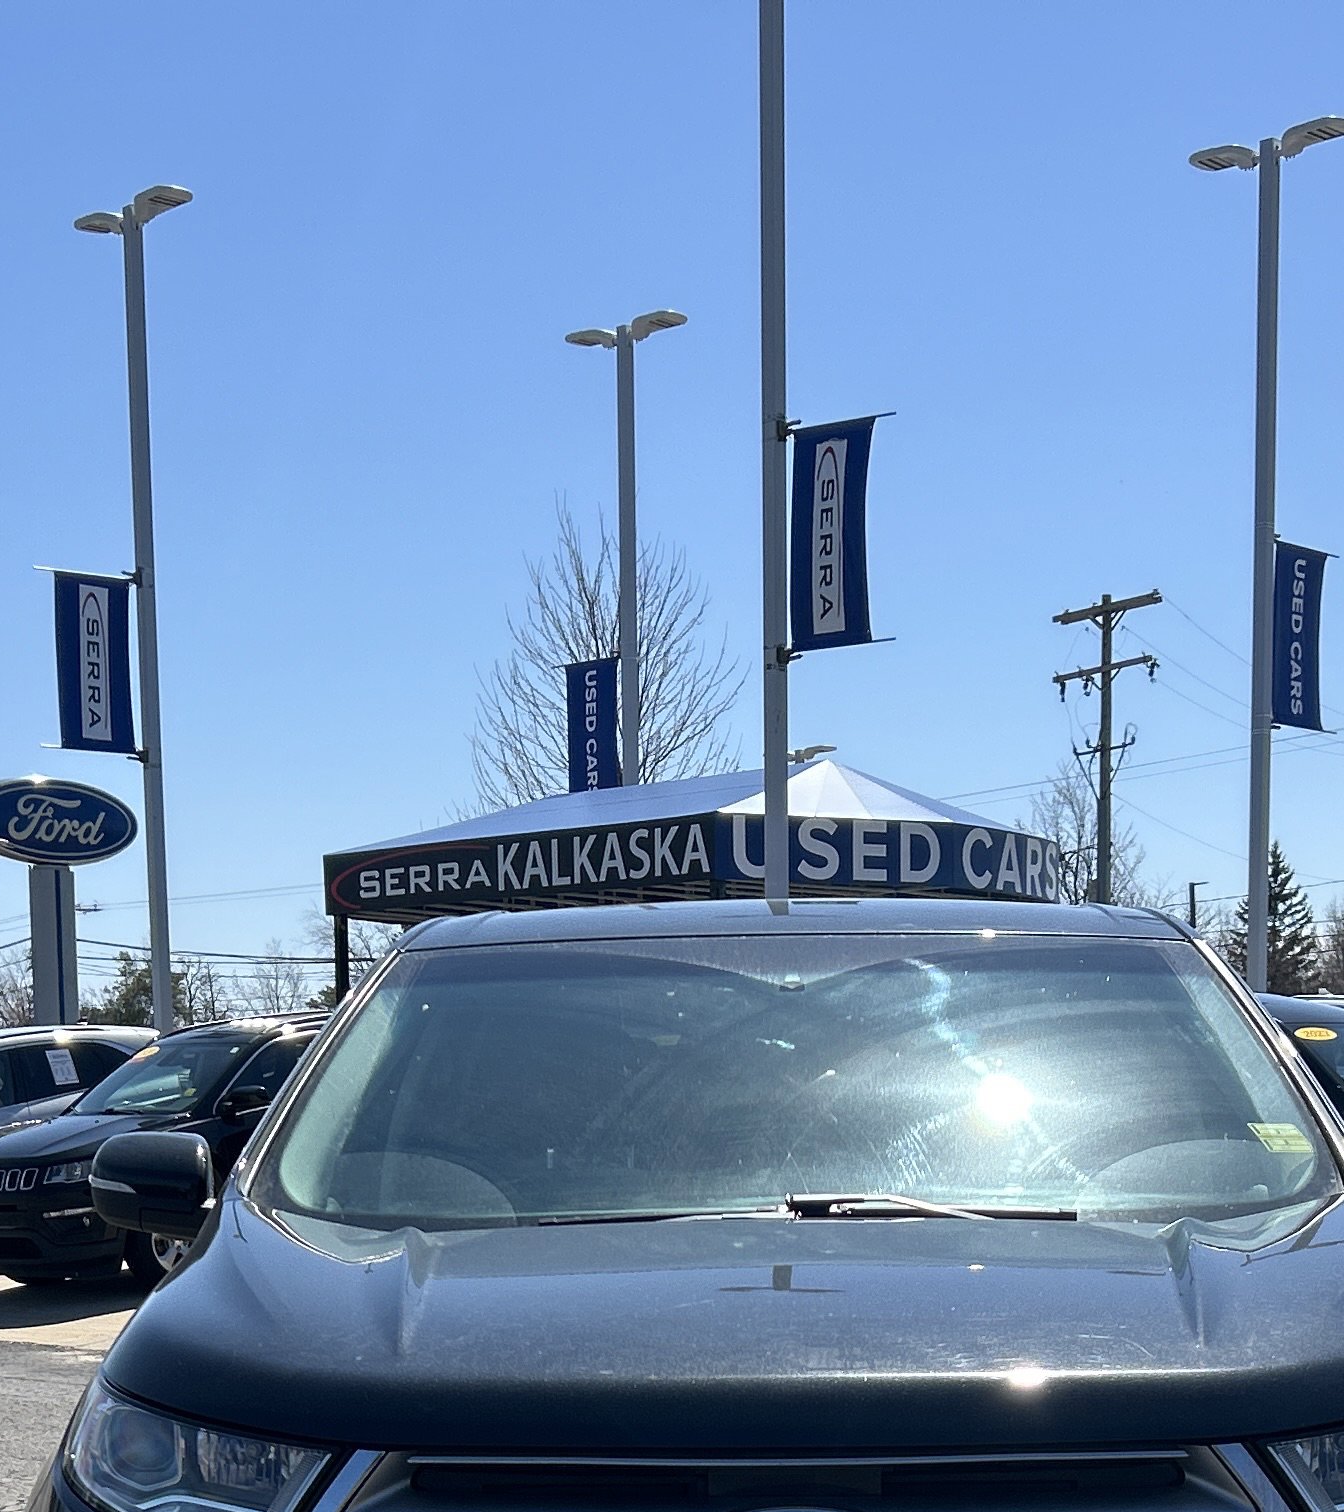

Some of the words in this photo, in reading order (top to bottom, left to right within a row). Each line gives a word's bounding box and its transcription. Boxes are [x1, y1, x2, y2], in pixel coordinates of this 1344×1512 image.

[819, 478, 835, 621] SERRA
[1290, 558, 1307, 634] USED
[86, 617, 102, 729] SERRA
[584, 669, 597, 733] USED
[1289, 641, 1304, 716] CARS
[7, 793, 106, 846] Ford
[732, 814, 942, 884] USED
[962, 827, 1057, 901] CARS
[359, 859, 491, 900] SERRA
[496, 823, 711, 892] KALKASKA
